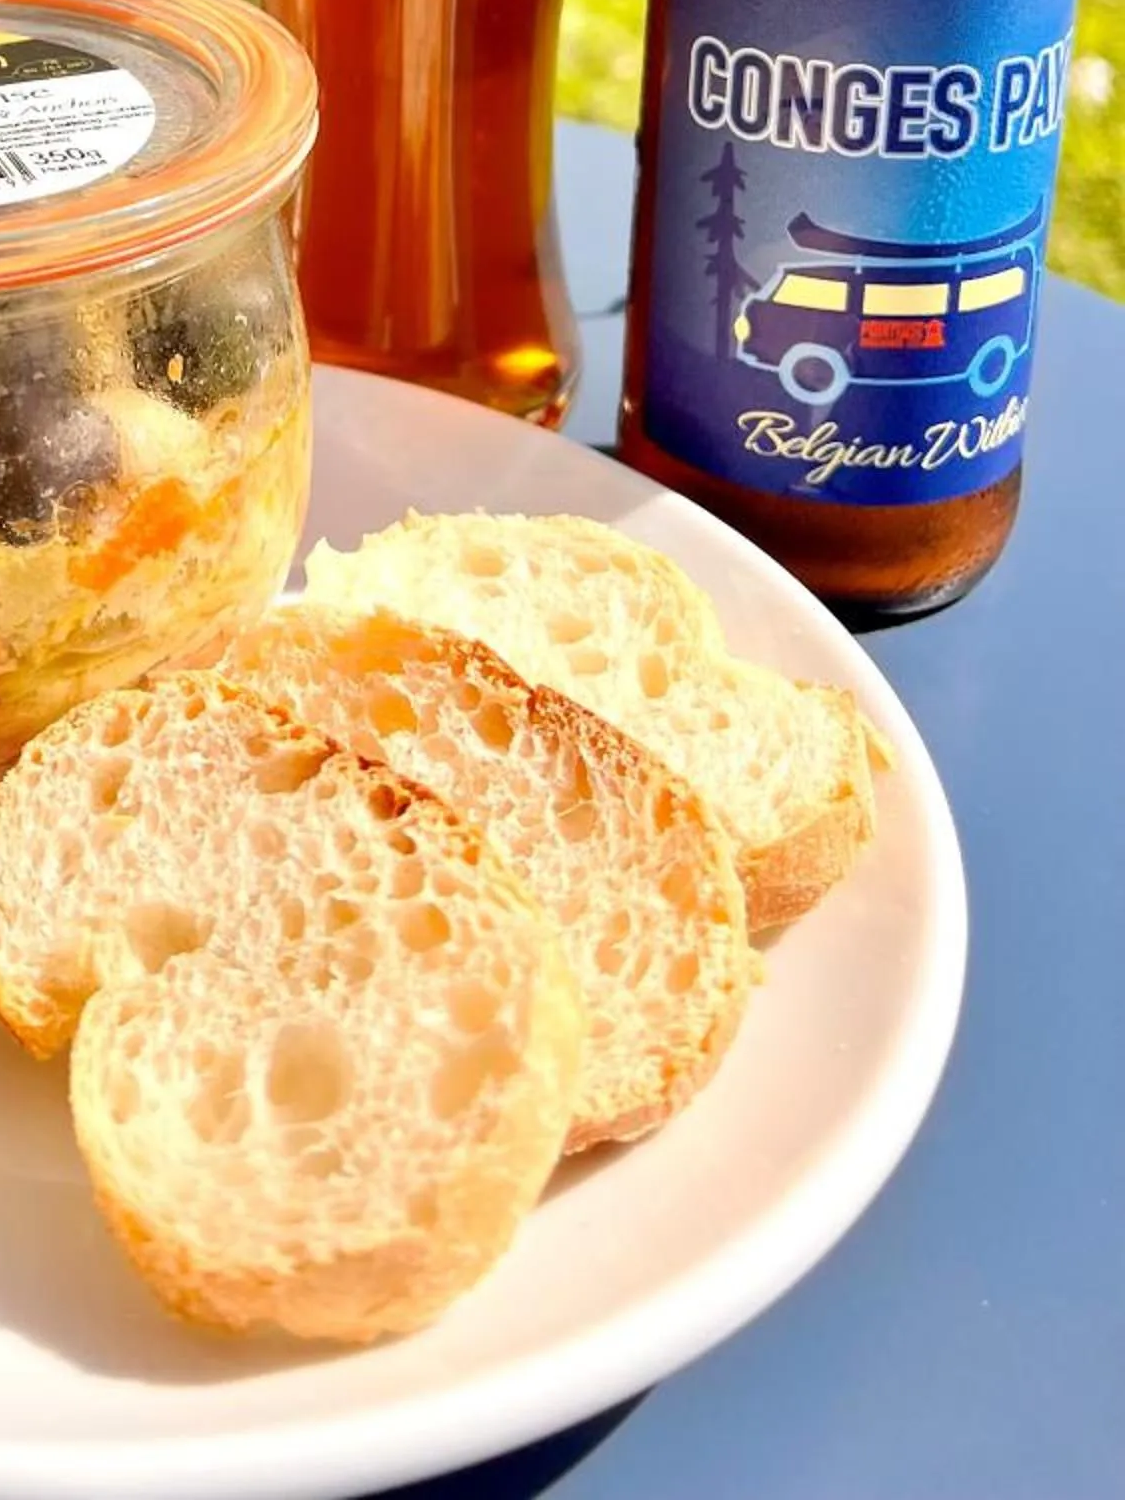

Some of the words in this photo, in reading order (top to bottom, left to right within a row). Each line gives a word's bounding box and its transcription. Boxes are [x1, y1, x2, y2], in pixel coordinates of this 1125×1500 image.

[688, 35, 982, 160] CONGES
[28, 147, 103, 168] 350g
[738, 411, 922, 485] Belgian
